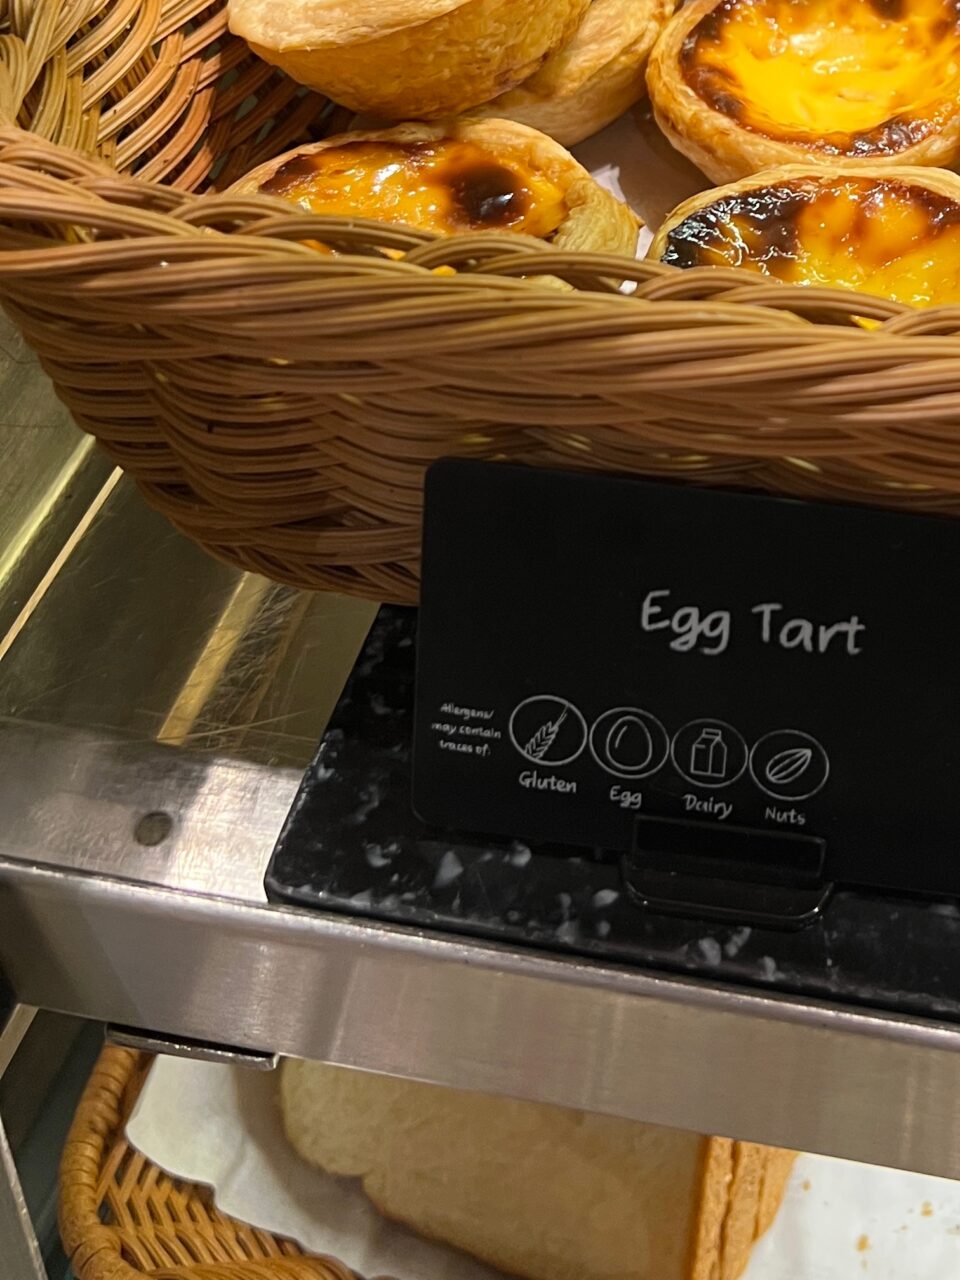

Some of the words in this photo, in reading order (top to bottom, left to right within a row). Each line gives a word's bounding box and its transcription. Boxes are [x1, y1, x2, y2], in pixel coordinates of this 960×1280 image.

[641, 589, 731, 655] Egg
[751, 602, 866, 655] Tart
[431, 722, 457, 736] may
[459, 725, 502, 739] contain
[440, 739, 474, 754] traces
[518, 770, 577, 794] Gluten
[609, 785, 642, 809] Egg
[682, 793, 733, 820] Dairy
[764, 807, 806, 825] Nuts
